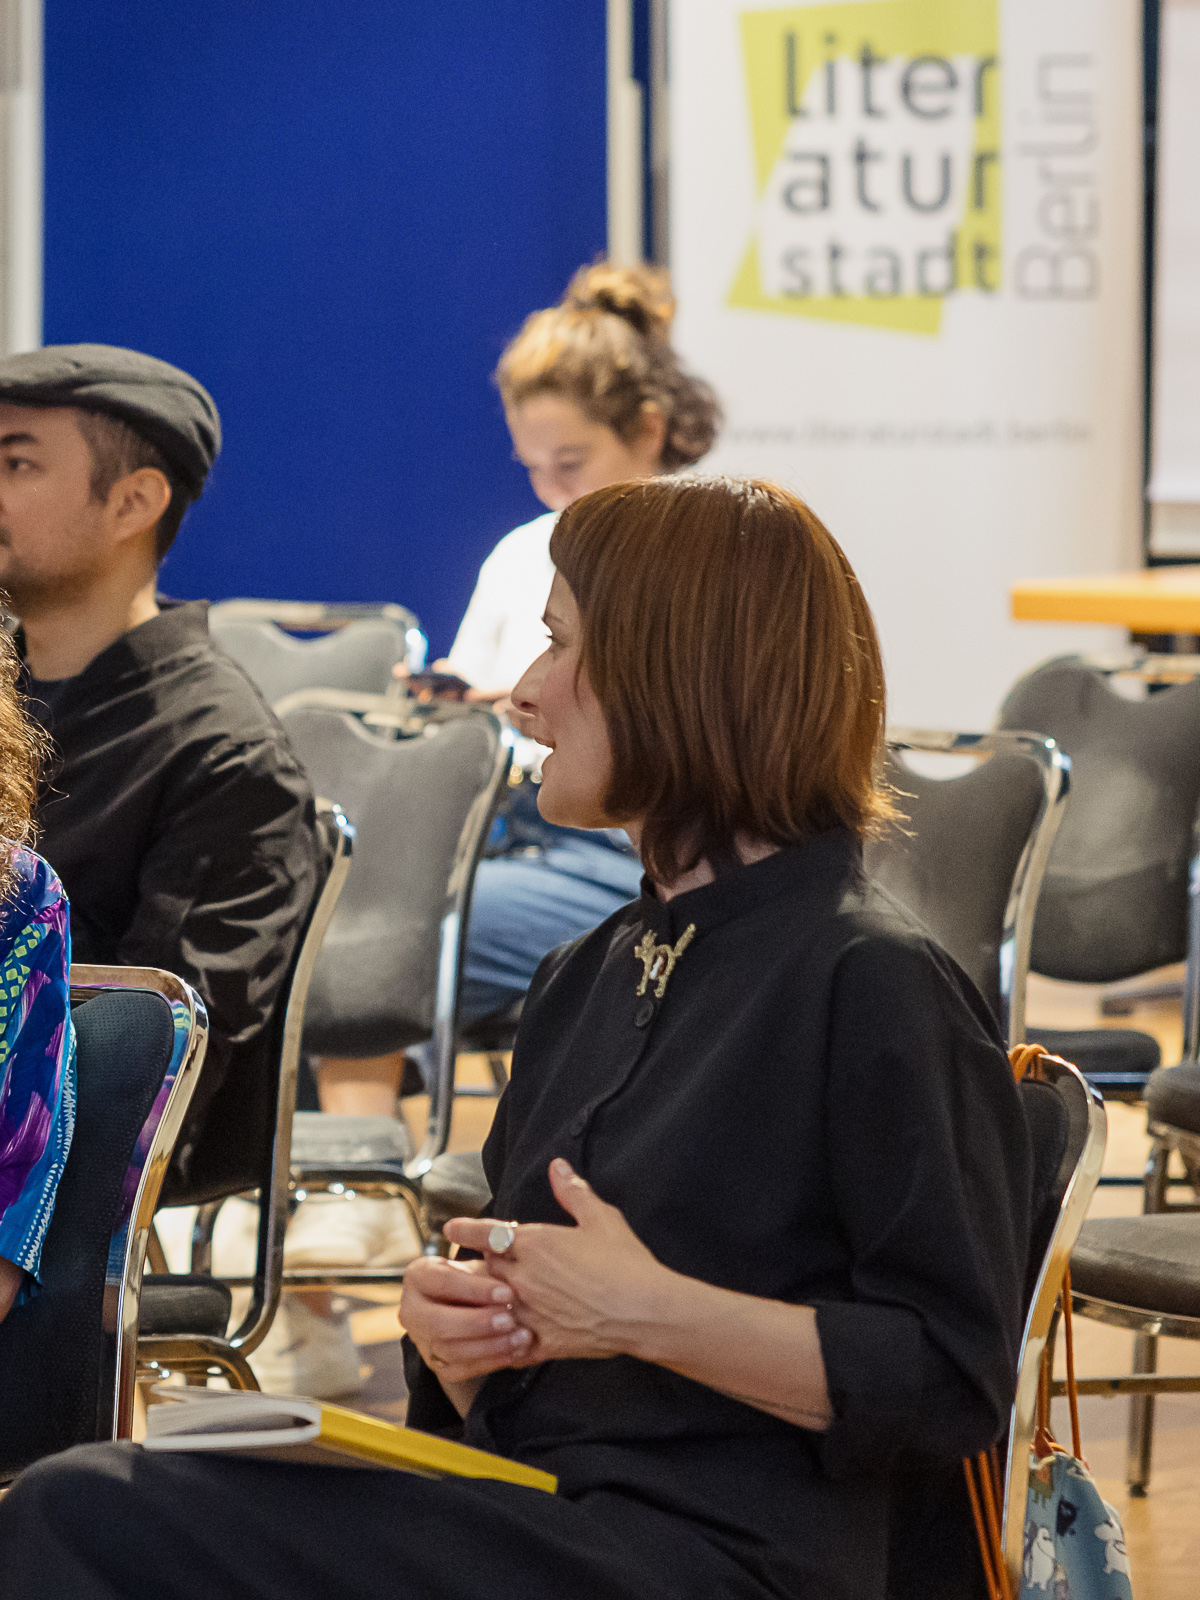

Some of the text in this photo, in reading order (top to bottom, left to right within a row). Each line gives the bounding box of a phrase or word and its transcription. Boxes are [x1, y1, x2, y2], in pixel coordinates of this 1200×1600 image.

[782, 30, 998, 121] liter
[780, 137, 999, 215] atur
[1013, 52, 1099, 303] Berlin
[780, 231, 997, 301] stadt
